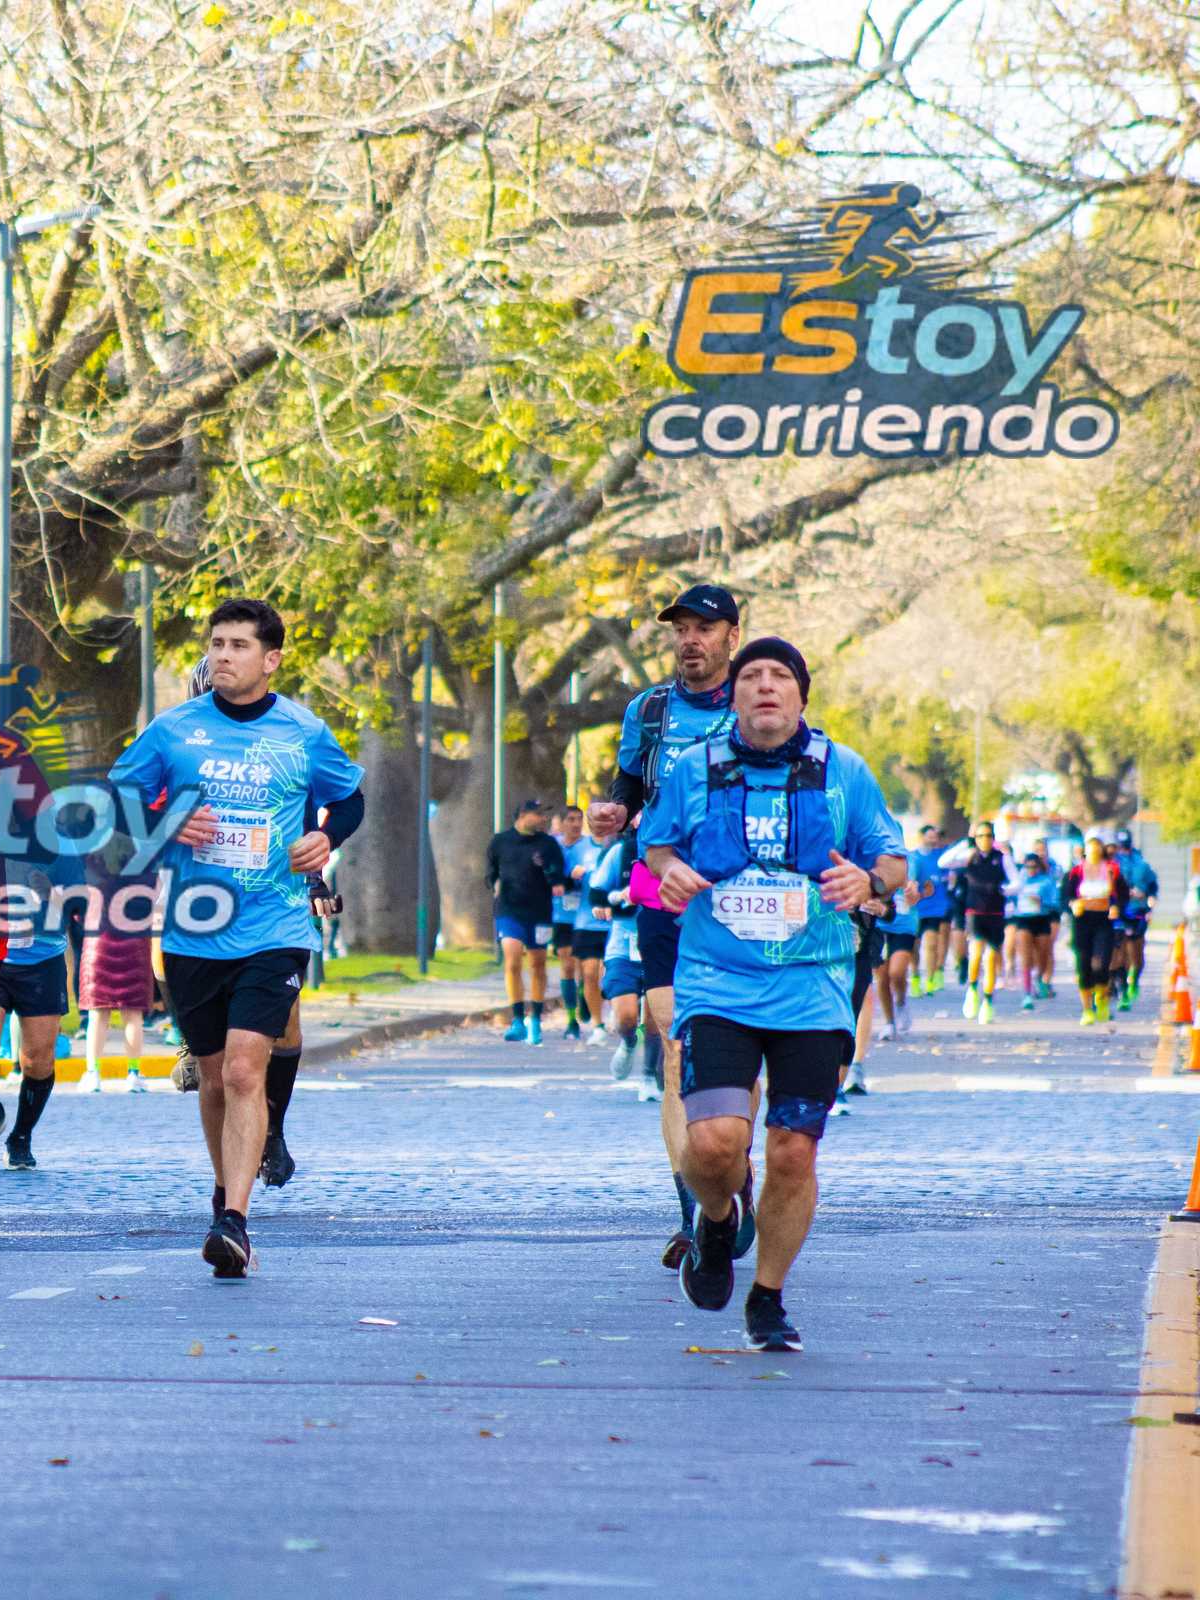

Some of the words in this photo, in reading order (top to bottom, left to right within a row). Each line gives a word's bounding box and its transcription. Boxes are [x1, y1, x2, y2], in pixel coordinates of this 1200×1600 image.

[199, 760, 250, 781] 42K
[745, 816, 778, 840] 2K
[720, 896, 777, 914] C3128
